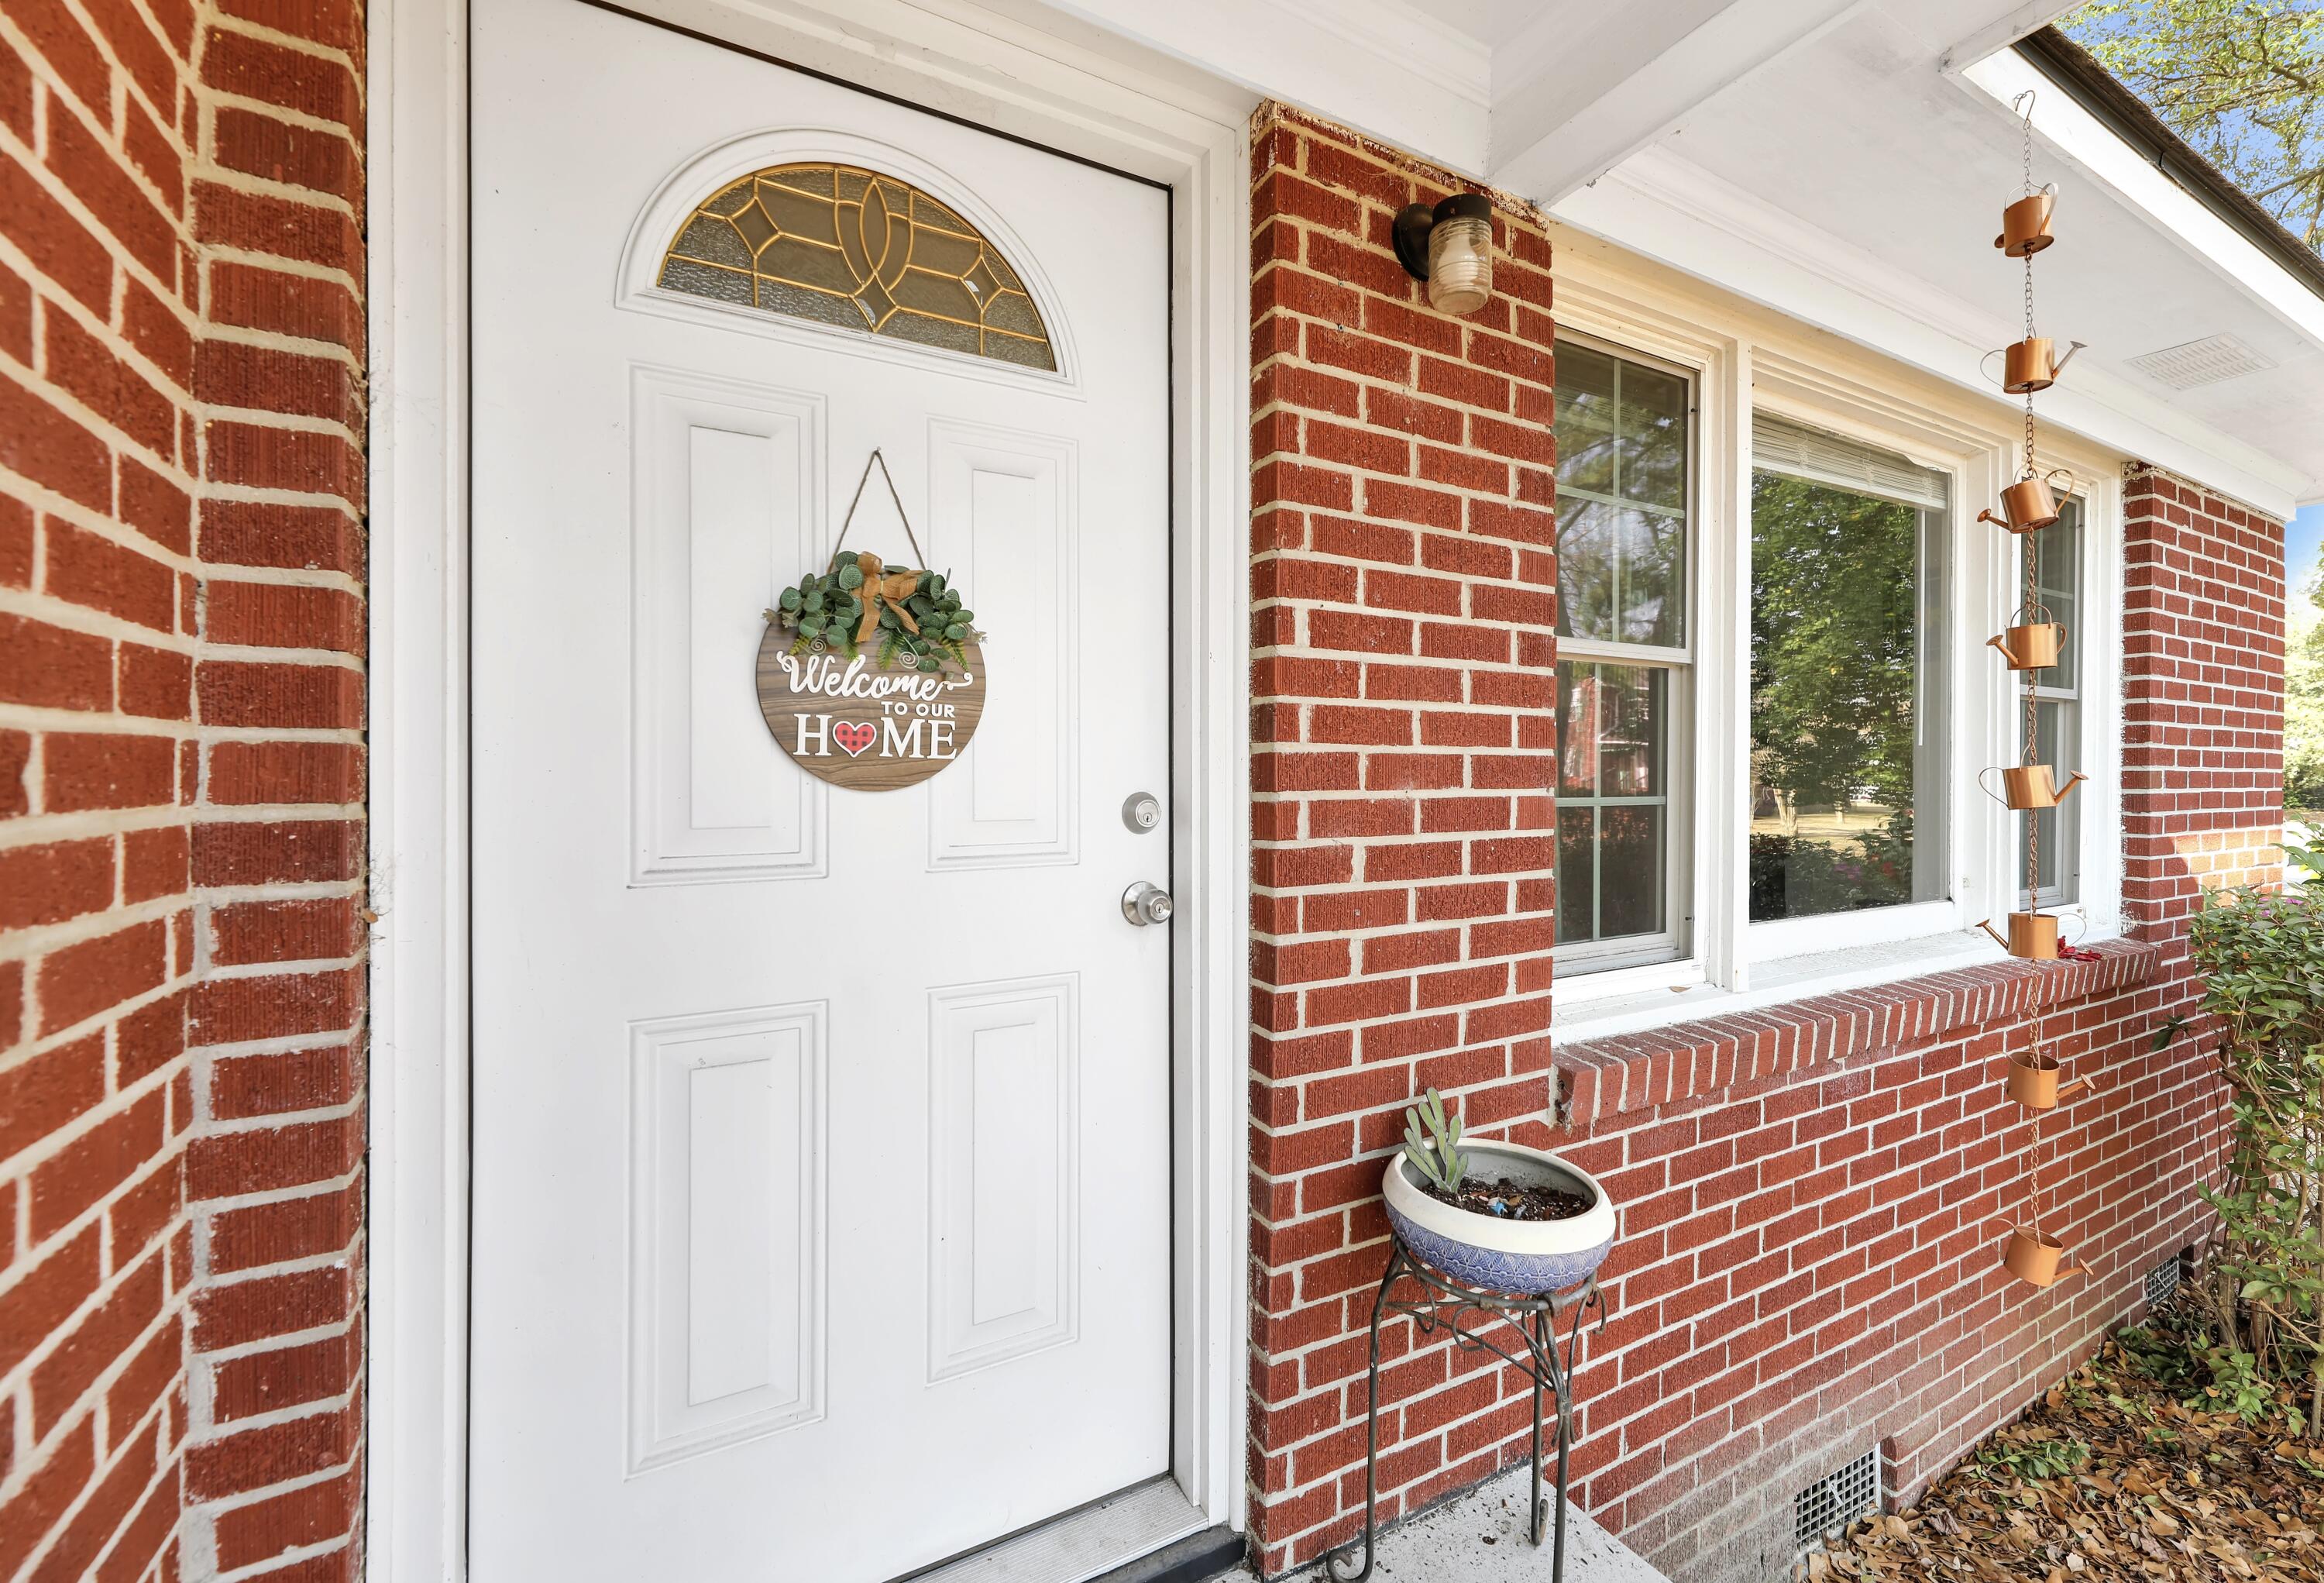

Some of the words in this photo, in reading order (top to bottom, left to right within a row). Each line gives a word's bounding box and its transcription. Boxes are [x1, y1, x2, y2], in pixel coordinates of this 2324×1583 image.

[776, 651, 973, 701] Welcome
[881, 701, 908, 716] TO
[916, 703, 955, 718] OUR
